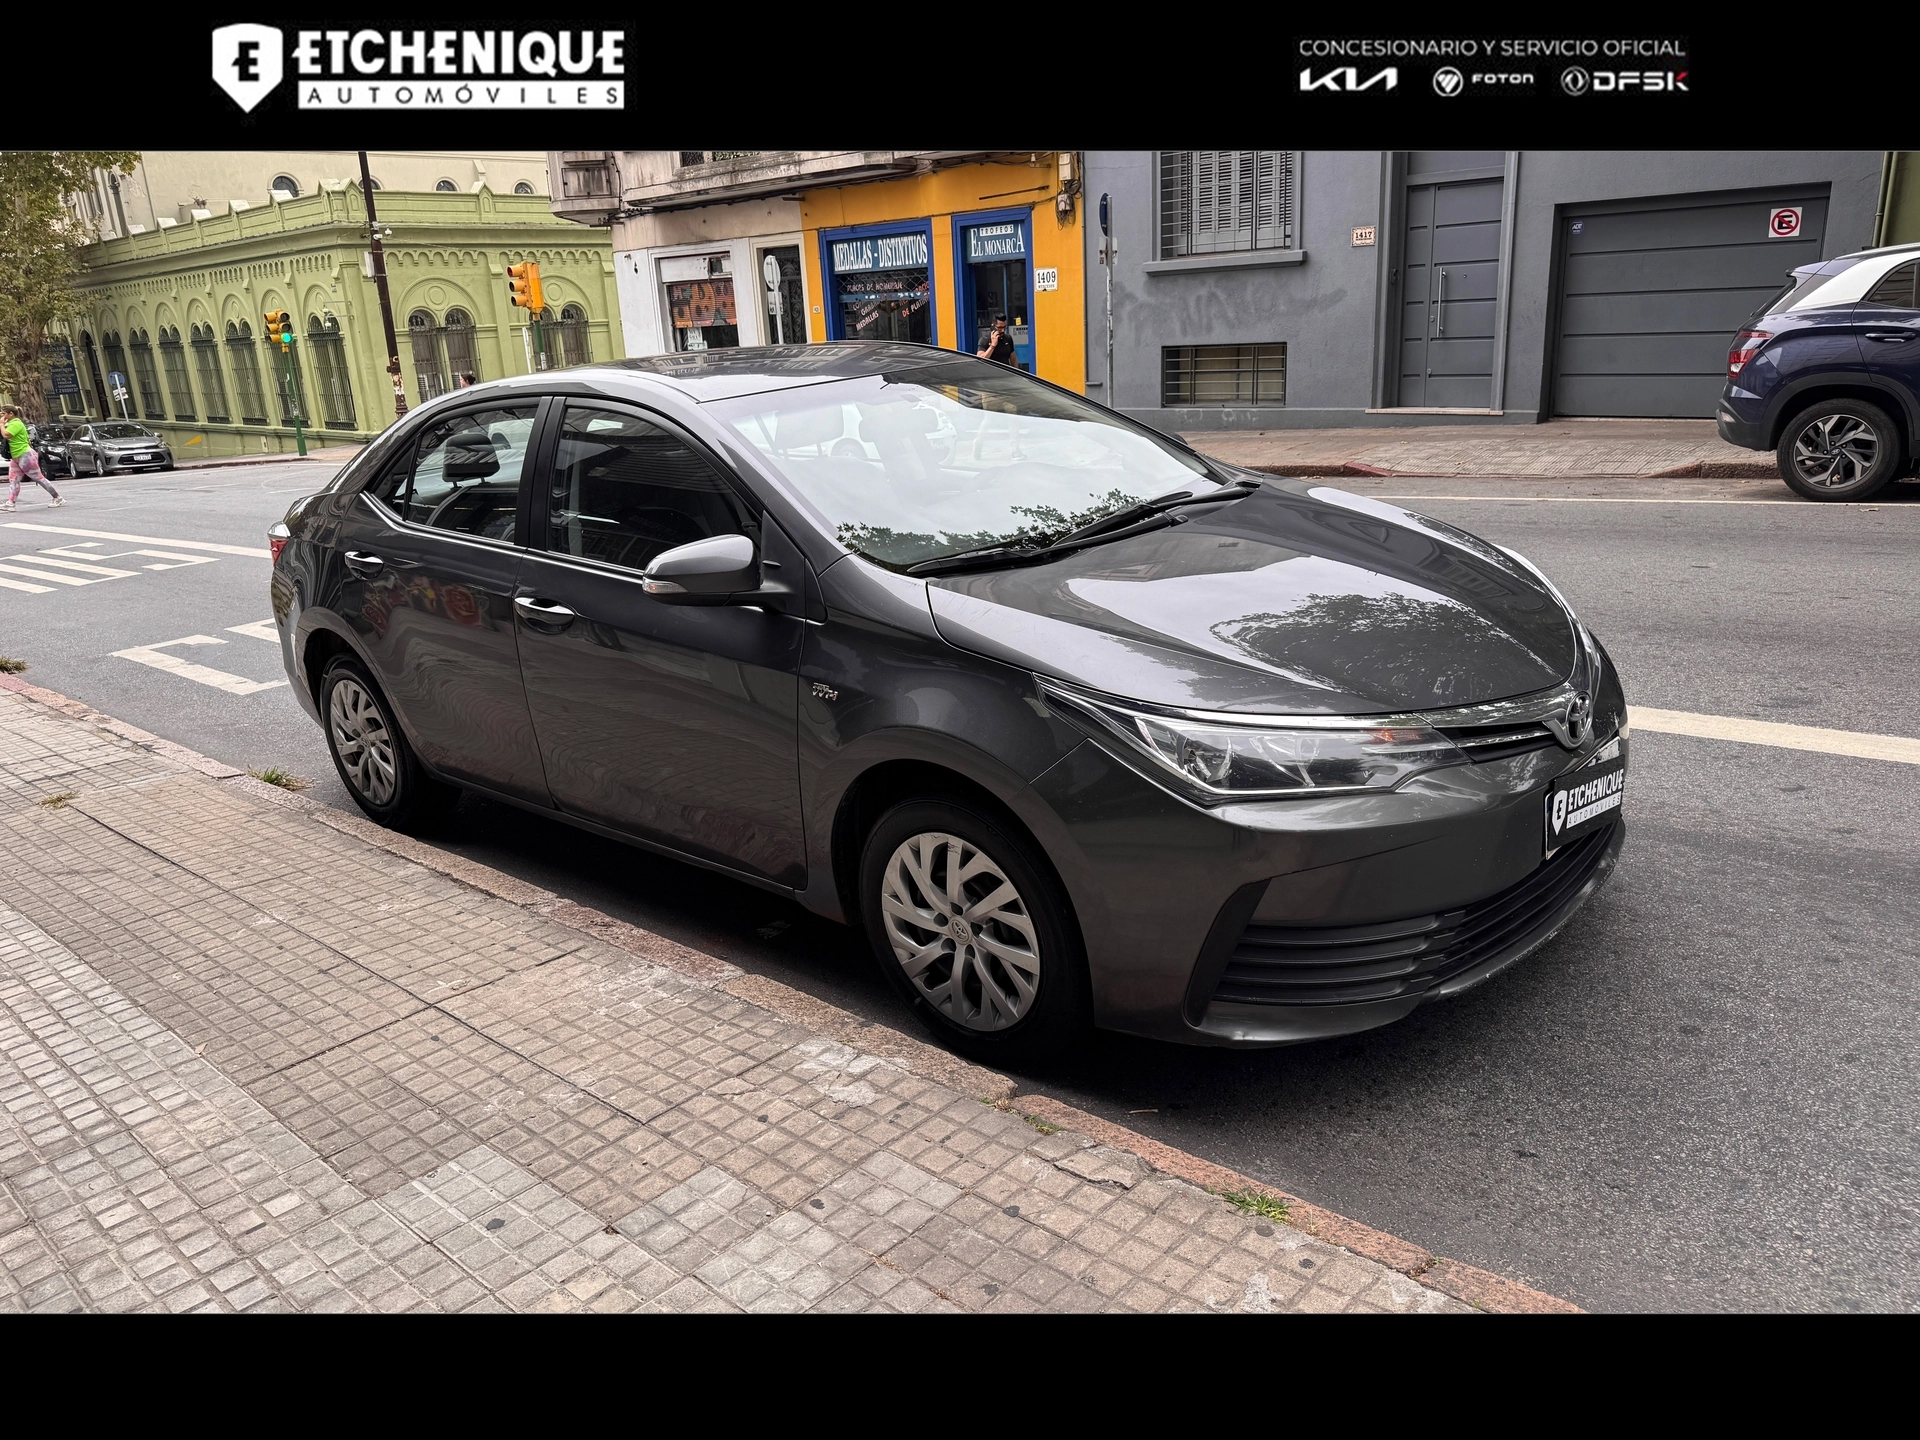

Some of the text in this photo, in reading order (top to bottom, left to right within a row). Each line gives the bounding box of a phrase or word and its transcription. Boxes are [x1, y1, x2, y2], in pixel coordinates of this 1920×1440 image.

[980, 225, 1014, 236] TROFEOS
[984, 223, 1026, 256] MONARCA
[1355, 231, 1373, 239] 1417
[833, 239, 873, 272] MEDALLAS
[877, 233, 928, 268] DISTINTIVOS
[1037, 271, 1056, 284] 1409
[856, 310, 879, 331] MEDALLAS
[1568, 769, 1624, 812] ETCHENIQUE
